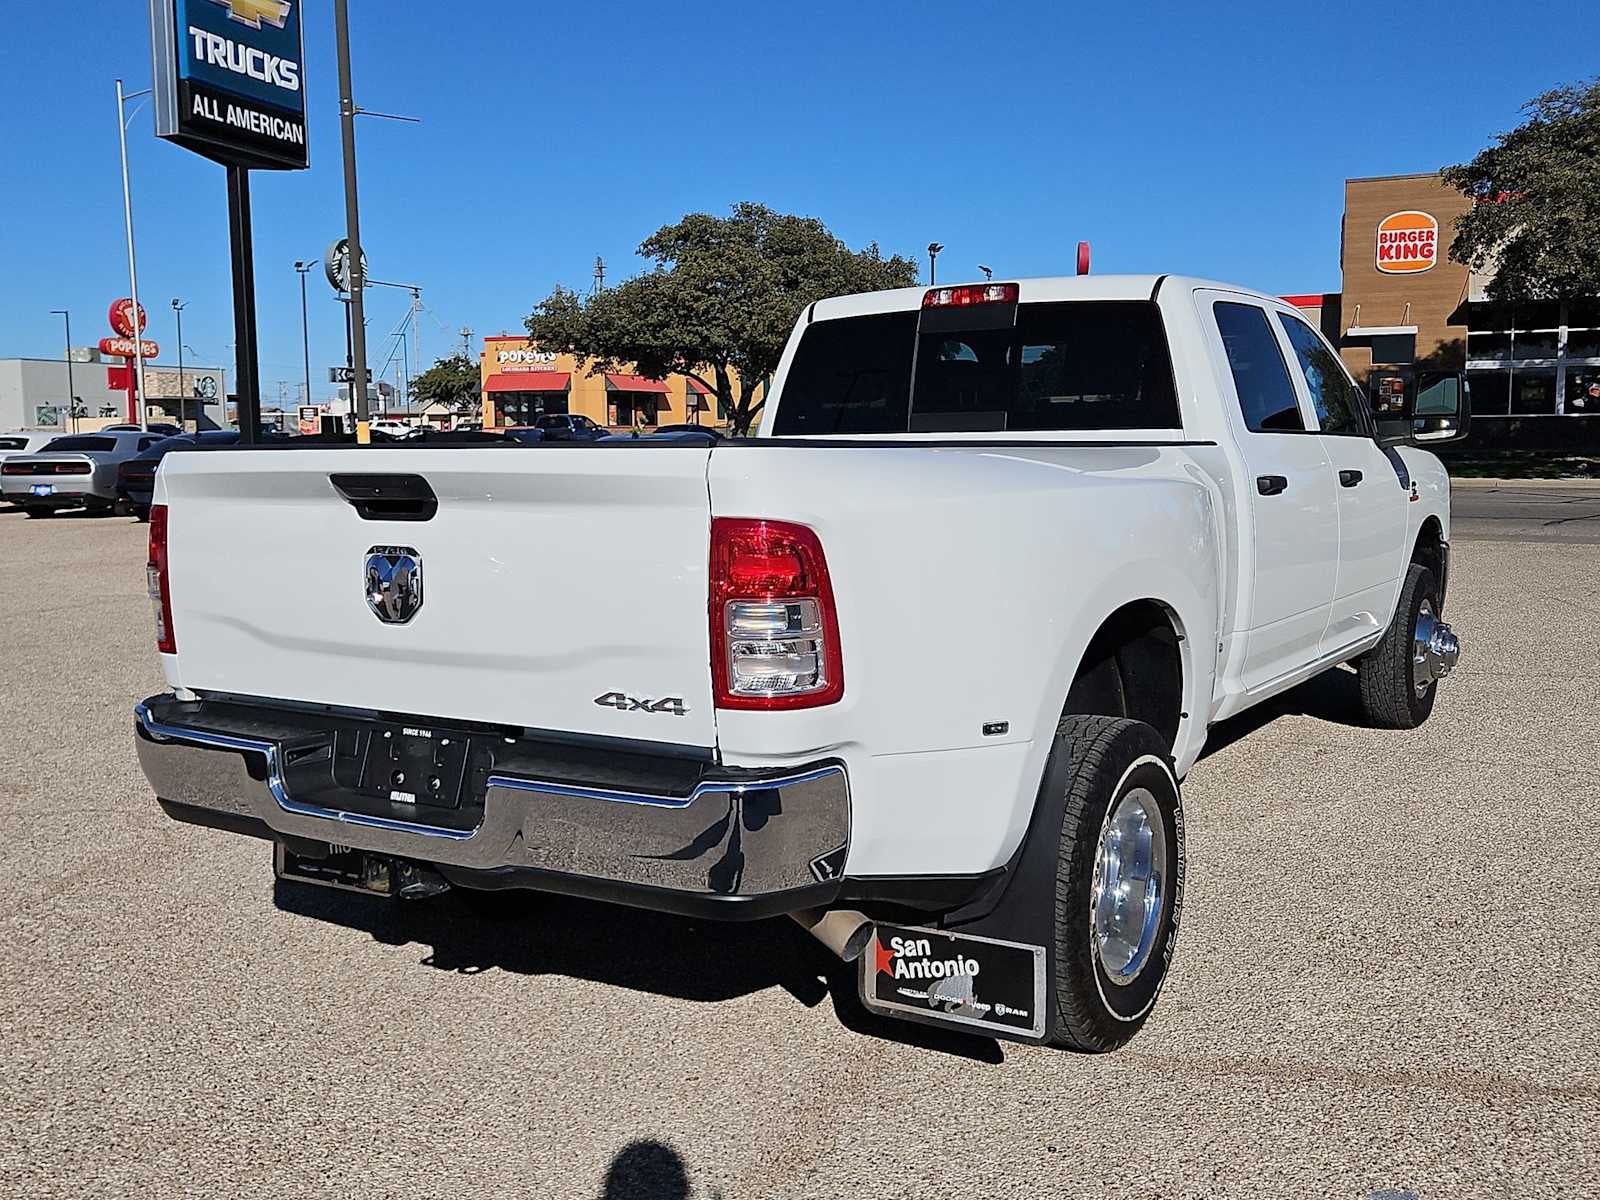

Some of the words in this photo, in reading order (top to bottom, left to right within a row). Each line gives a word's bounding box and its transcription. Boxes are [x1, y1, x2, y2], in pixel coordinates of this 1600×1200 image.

[189, 26, 299, 91] TRUCKS
[193, 94, 224, 122] ALL
[226, 104, 304, 145] AMERICAN
[1379, 230, 1435, 244] BURGER
[1379, 242, 1435, 261] KING
[402, 727, 419, 737] SINCE
[890, 936, 931, 958] San
[894, 954, 980, 980] Antonio
[1005, 1007, 1028, 1017] RAM
